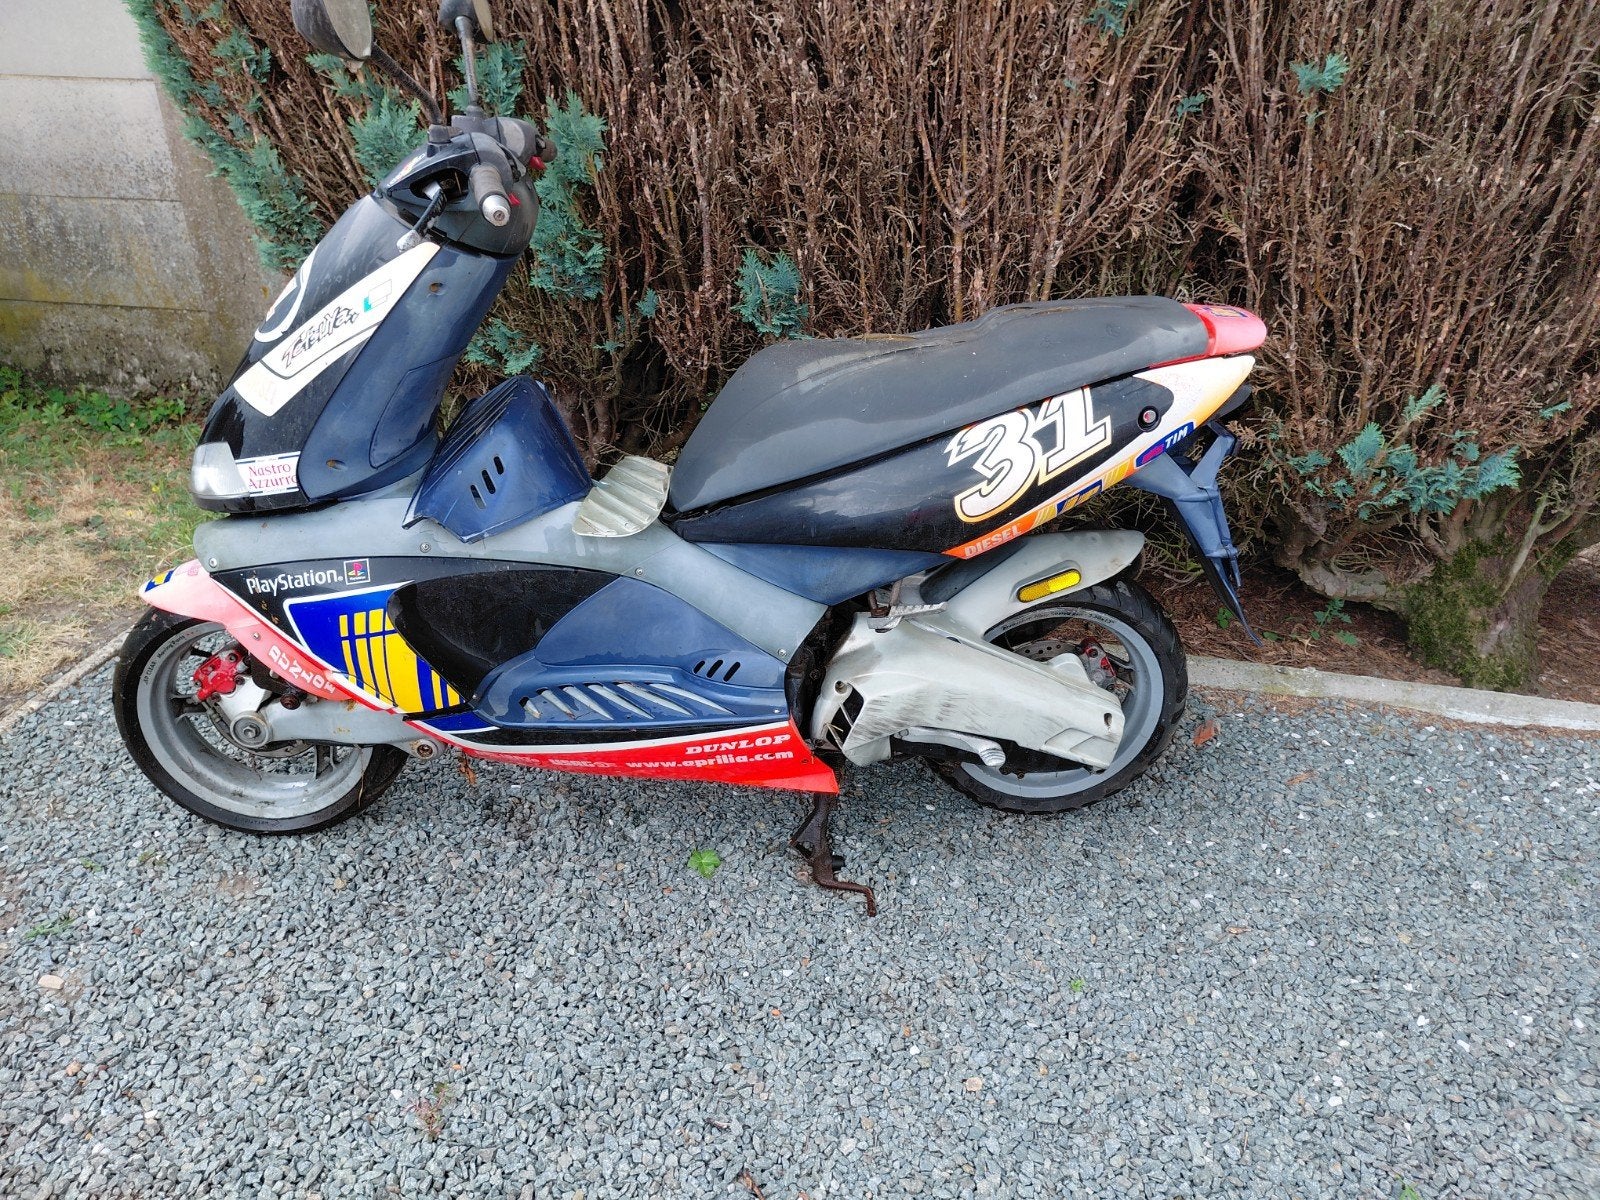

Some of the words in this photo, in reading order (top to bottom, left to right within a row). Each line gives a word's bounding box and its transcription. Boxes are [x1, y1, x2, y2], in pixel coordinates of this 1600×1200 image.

[1165, 425, 1189, 450] TIM
[944, 386, 1112, 523] 31
[248, 463, 292, 478] Nastro
[964, 523, 1022, 558] DIESEL
[685, 733, 792, 756] DUNLOP
